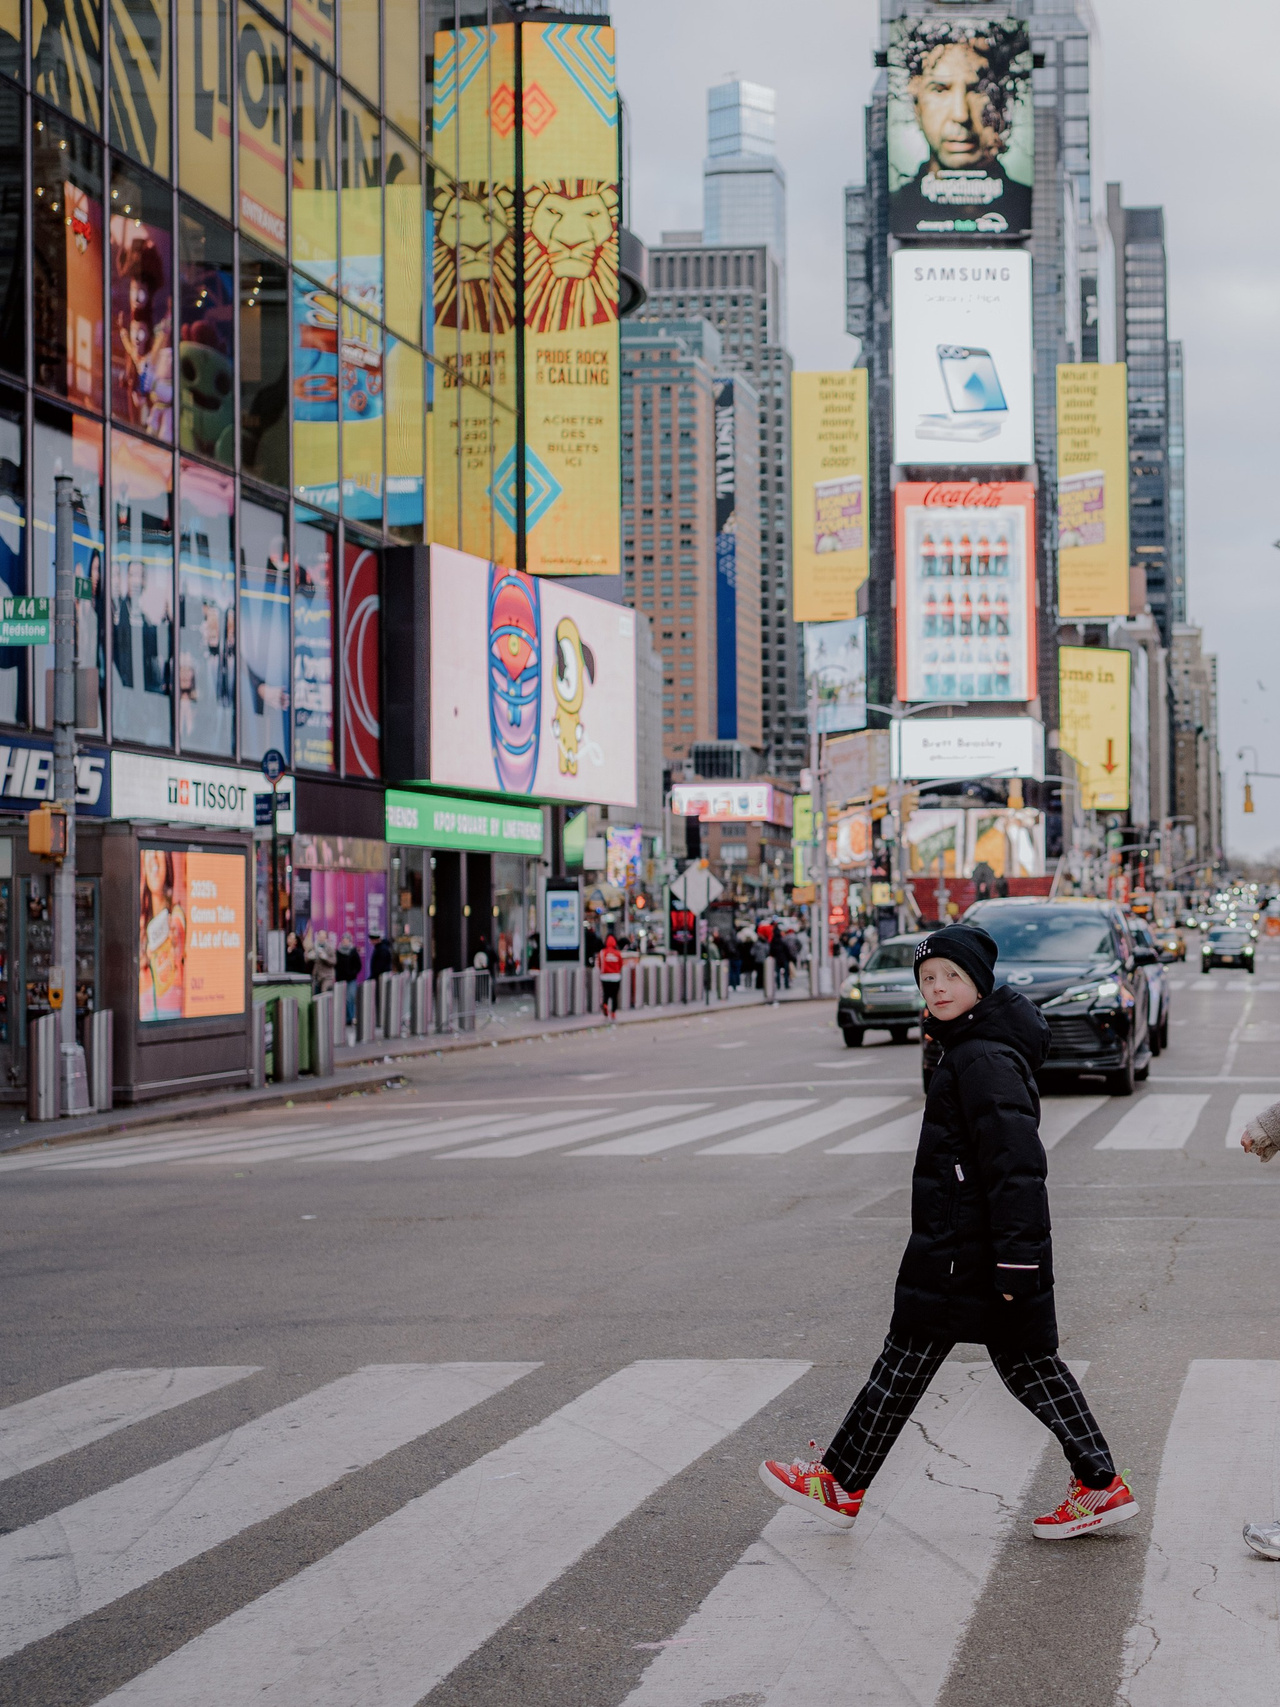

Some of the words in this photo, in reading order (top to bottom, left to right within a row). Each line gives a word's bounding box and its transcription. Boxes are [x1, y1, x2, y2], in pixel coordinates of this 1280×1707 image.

[914, 267, 1011, 282] SAMSUNG
[537, 350, 570, 365] PRIDE
[576, 351, 608, 365] ROCK
[549, 366, 610, 386] CALLING
[818, 375, 844, 386] What
[1060, 370, 1088, 381] What
[819, 389, 856, 402] talking
[823, 403, 852, 414] about
[1065, 398, 1095, 409] about
[543, 416, 604, 427] ACHETER
[820, 417, 855, 429] money
[1063, 413, 1097, 424] money
[561, 431, 586, 441] DES
[816, 430, 859, 442] actually
[548, 445, 600, 455] BILLETS
[565, 458, 583, 469] ICI
[4, 599, 15, 619] W
[18, 599, 35, 619] 44
[1097, 666, 1115, 683] in
[192, 781, 247, 811] TISSOT
[386, 804, 419, 829] RIENDS
[433, 810, 456, 832] KPOP
[457, 813, 488, 836] SQUARE
[490, 817, 500, 837] BY
[191, 905, 216, 923] Gonna
[217, 905, 236, 923] Take
[191, 931, 198, 948] A
[199, 931, 212, 948] Lot
